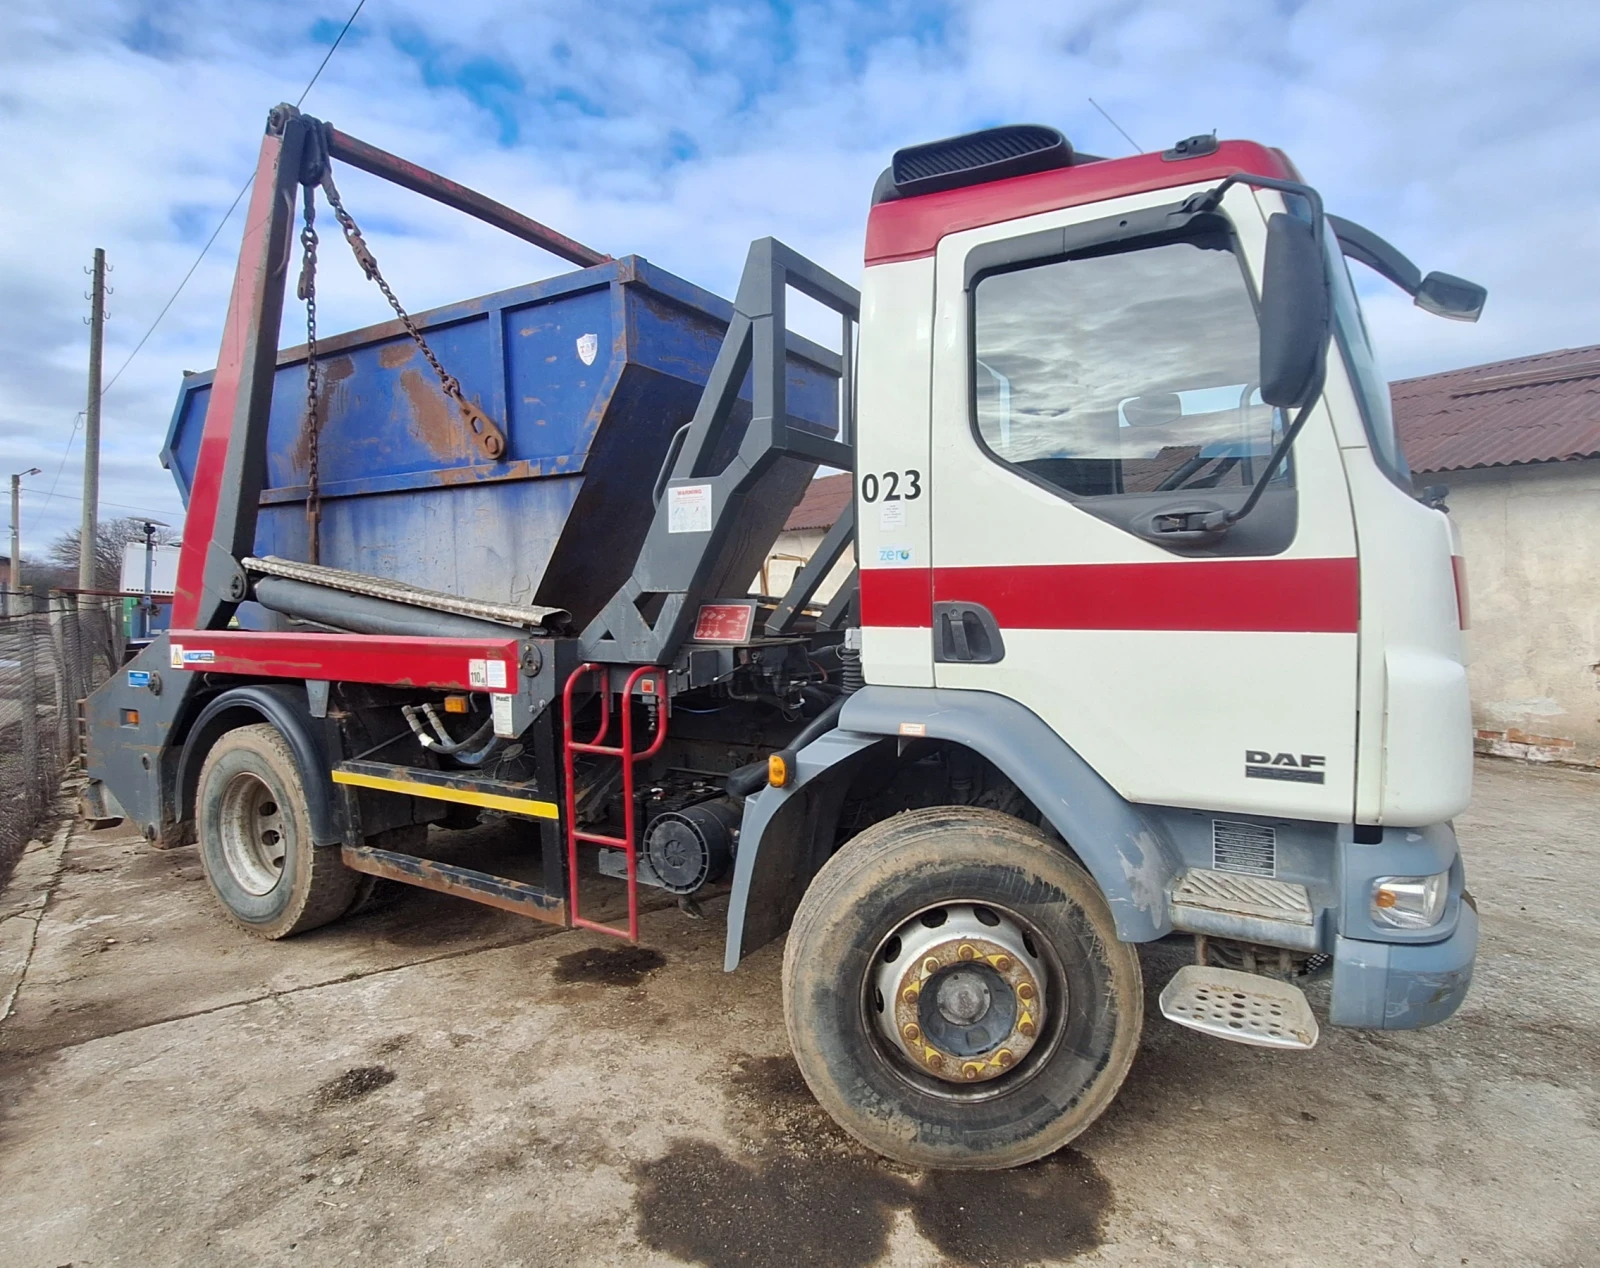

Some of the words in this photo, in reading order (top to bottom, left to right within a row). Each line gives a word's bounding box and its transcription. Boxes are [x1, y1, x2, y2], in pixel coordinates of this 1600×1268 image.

[677, 488, 703, 496] WARNING
[862, 469, 921, 503] 023
[879, 549, 910, 561] zero
[471, 671, 481, 683] 110
[1246, 750, 1326, 768] DAF
